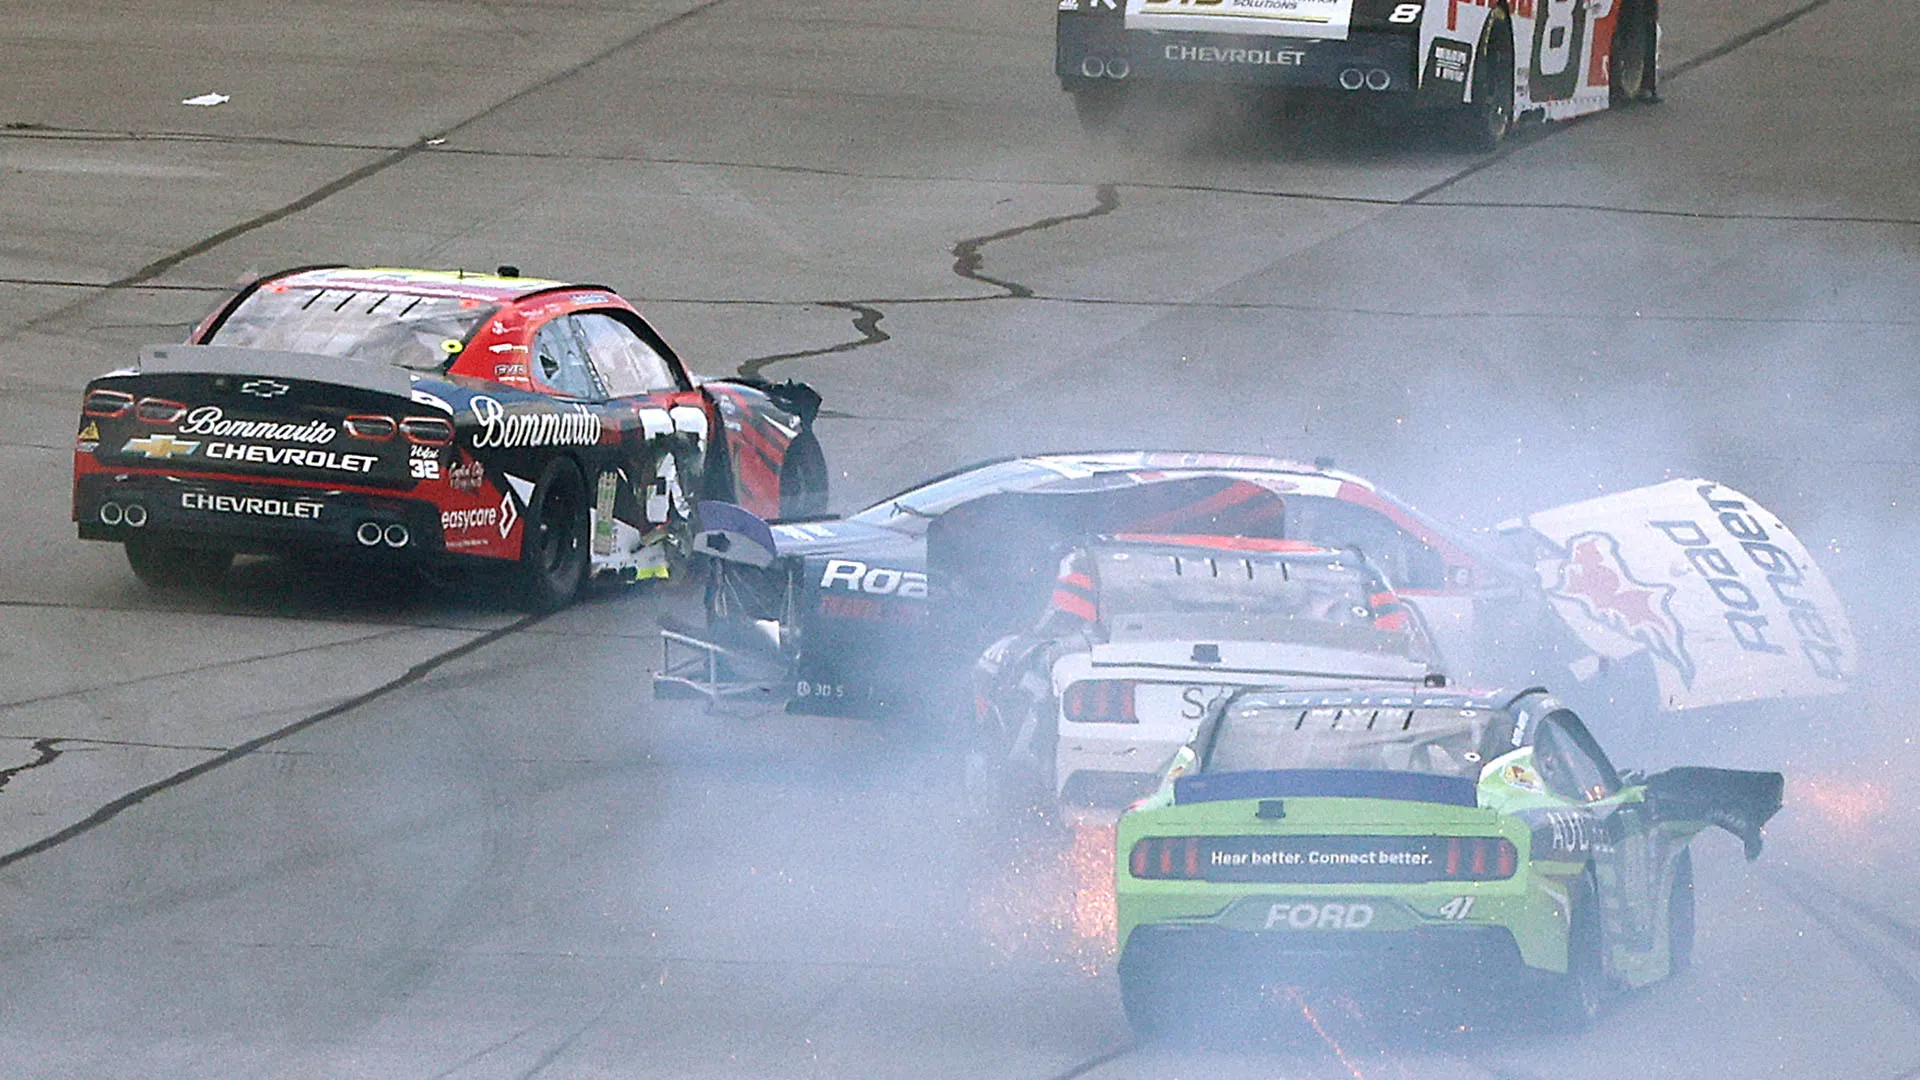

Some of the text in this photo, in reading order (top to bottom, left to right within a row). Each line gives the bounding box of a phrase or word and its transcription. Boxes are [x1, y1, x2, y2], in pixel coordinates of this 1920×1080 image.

[1232, 0, 1298, 10] SOLUTIONS
[1387, 3, 1423, 24] 8
[1164, 44, 1305, 67] CHEVROLET
[179, 405, 338, 446] Bommarito
[469, 394, 601, 450] Bommarito
[205, 442, 379, 474] CHEVROLET
[408, 458, 441, 479] 32
[181, 492, 325, 519] CHEVROLET
[440, 507, 498, 534] easycare
[820, 558, 929, 598] Roa
[1648, 520, 1786, 656] Road
[1211, 851, 1433, 866] Hear better. Connect better.
[1263, 903, 1374, 930] FORD
[1439, 895, 1475, 921] 41
